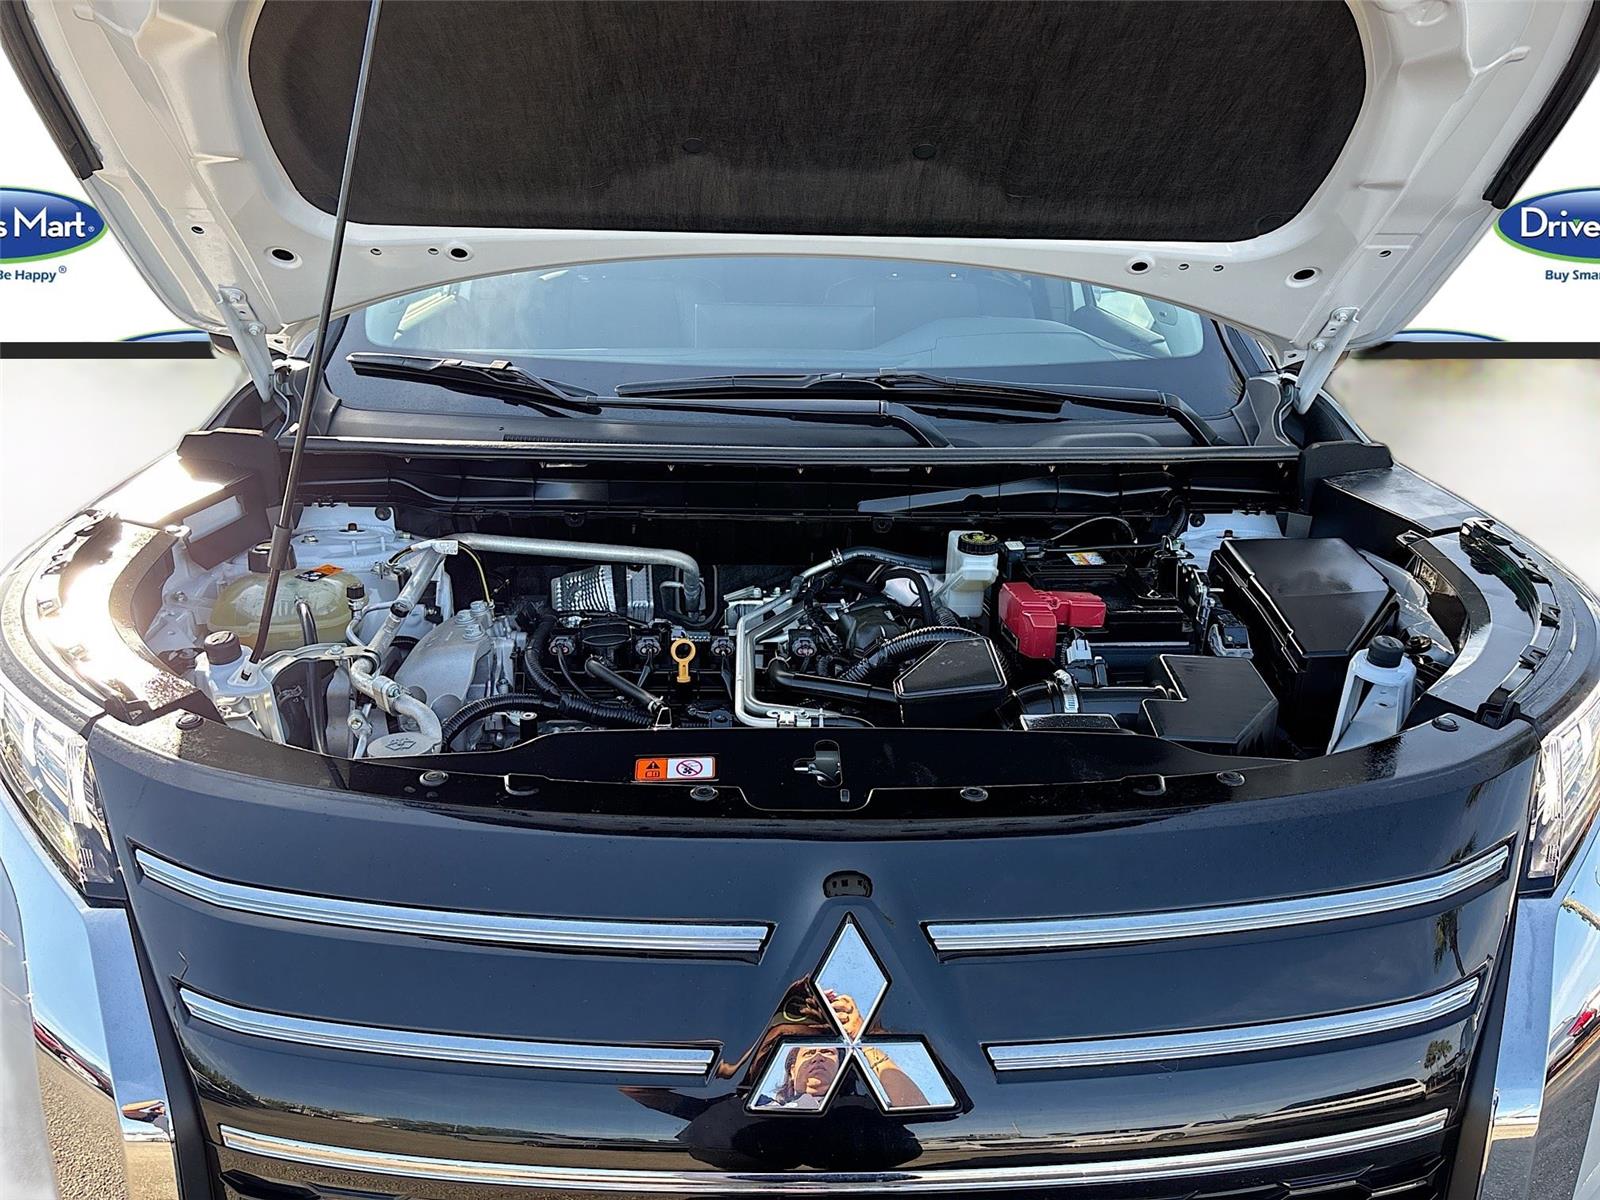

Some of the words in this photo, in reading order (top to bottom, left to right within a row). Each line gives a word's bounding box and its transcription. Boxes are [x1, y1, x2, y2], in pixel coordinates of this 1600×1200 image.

[1521, 207, 1600, 237] Drive
[1545, 270, 1569, 283] Buy
[1572, 269, 1600, 280] Sma
